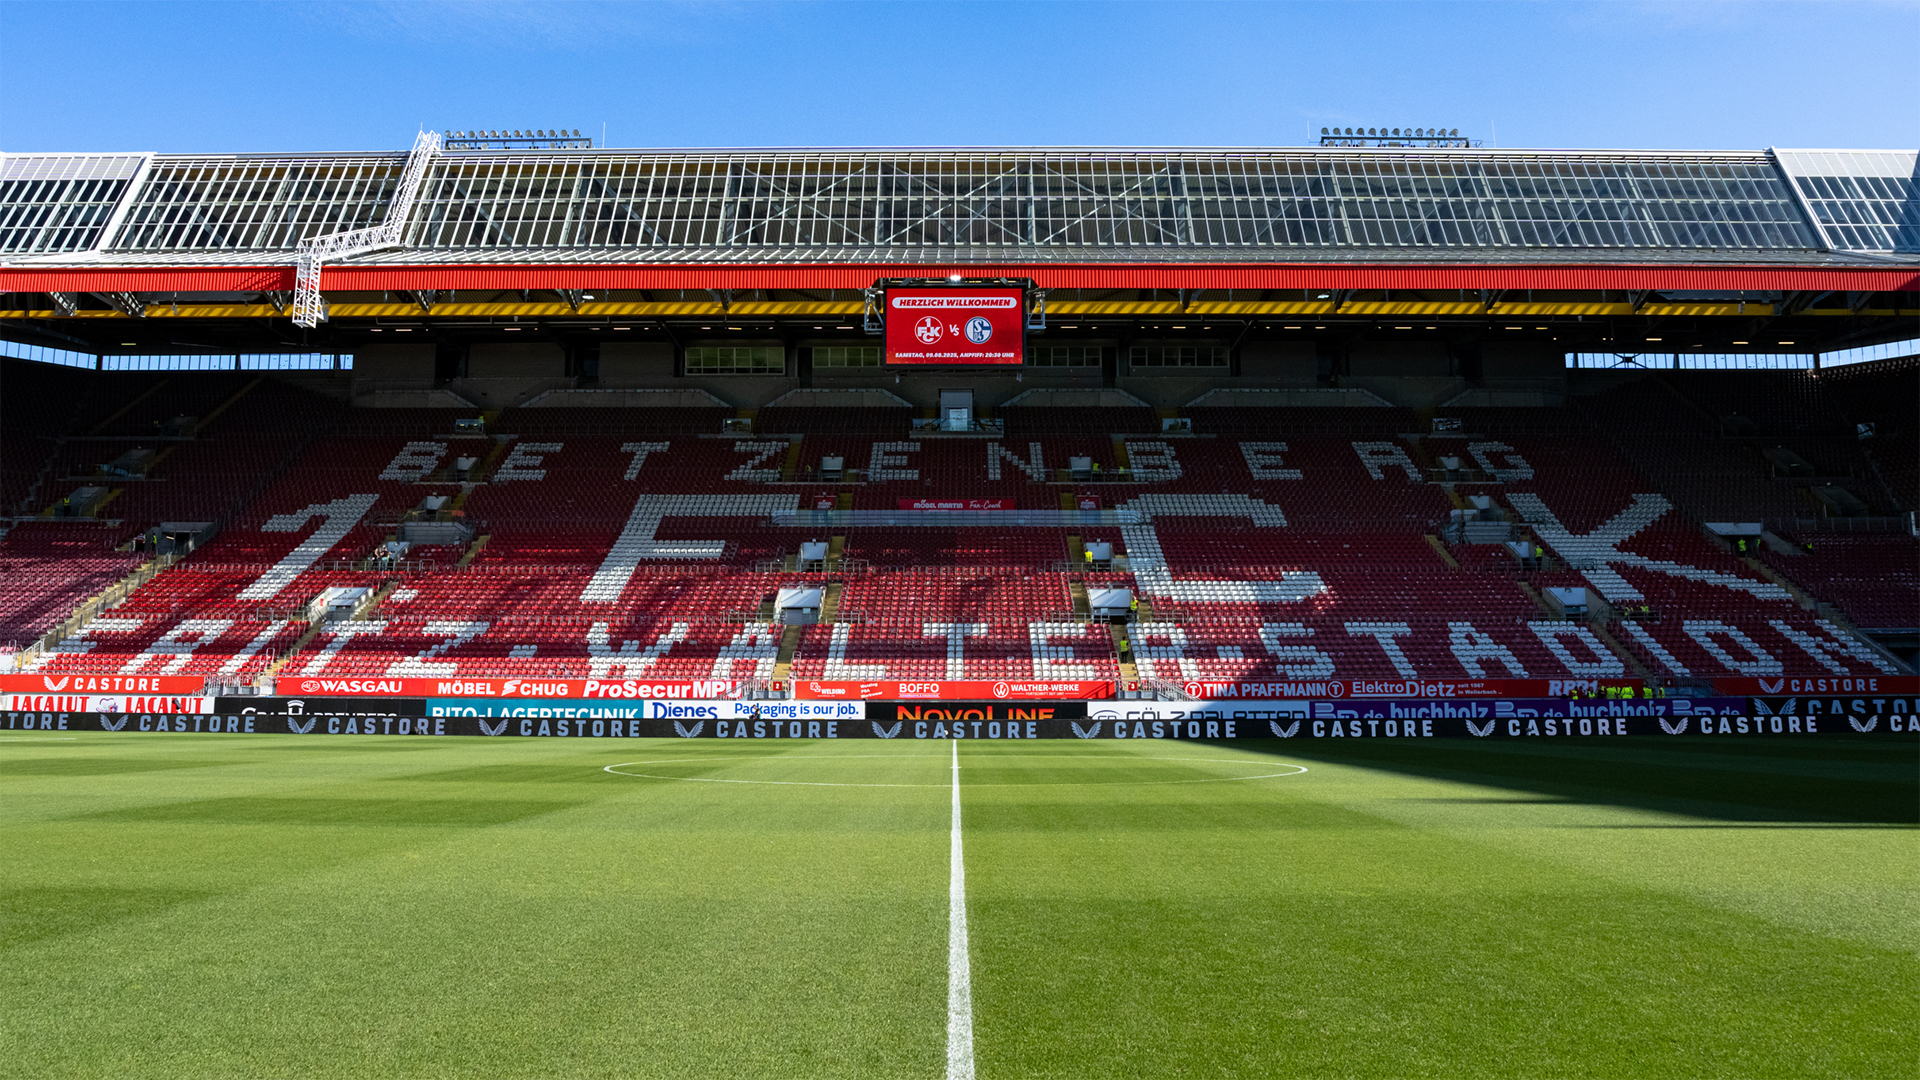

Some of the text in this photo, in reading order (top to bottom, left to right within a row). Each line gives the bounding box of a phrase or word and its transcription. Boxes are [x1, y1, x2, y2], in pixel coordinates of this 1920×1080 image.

[74, 678, 160, 691] CASTORE
[320, 680, 402, 692] WASGAU
[438, 680, 496, 694] MÖBEL
[899, 683, 940, 692] BOFFO
[1204, 682, 1238, 697] TINA
[1242, 682, 1326, 697] PFAFFMANN
[1791, 678, 1878, 692] CASTORE
[12, 696, 90, 712] LACALUT
[652, 702, 718, 719] Dienes
[800, 702, 810, 714] is
[813, 706, 834, 714] our
[836, 702, 859, 718] job.
[140, 716, 255, 732] CASTORE
[328, 717, 446, 735] CASTORE
[520, 720, 640, 736] CASTORE
[716, 721, 838, 738] CASTORE
[915, 722, 1037, 738] CASTORE
[1114, 721, 1236, 738] CASTORE
[1312, 720, 1434, 738] CASTORE
[1508, 718, 1627, 736] CASTORE
[1700, 716, 1818, 734] CASTORE
